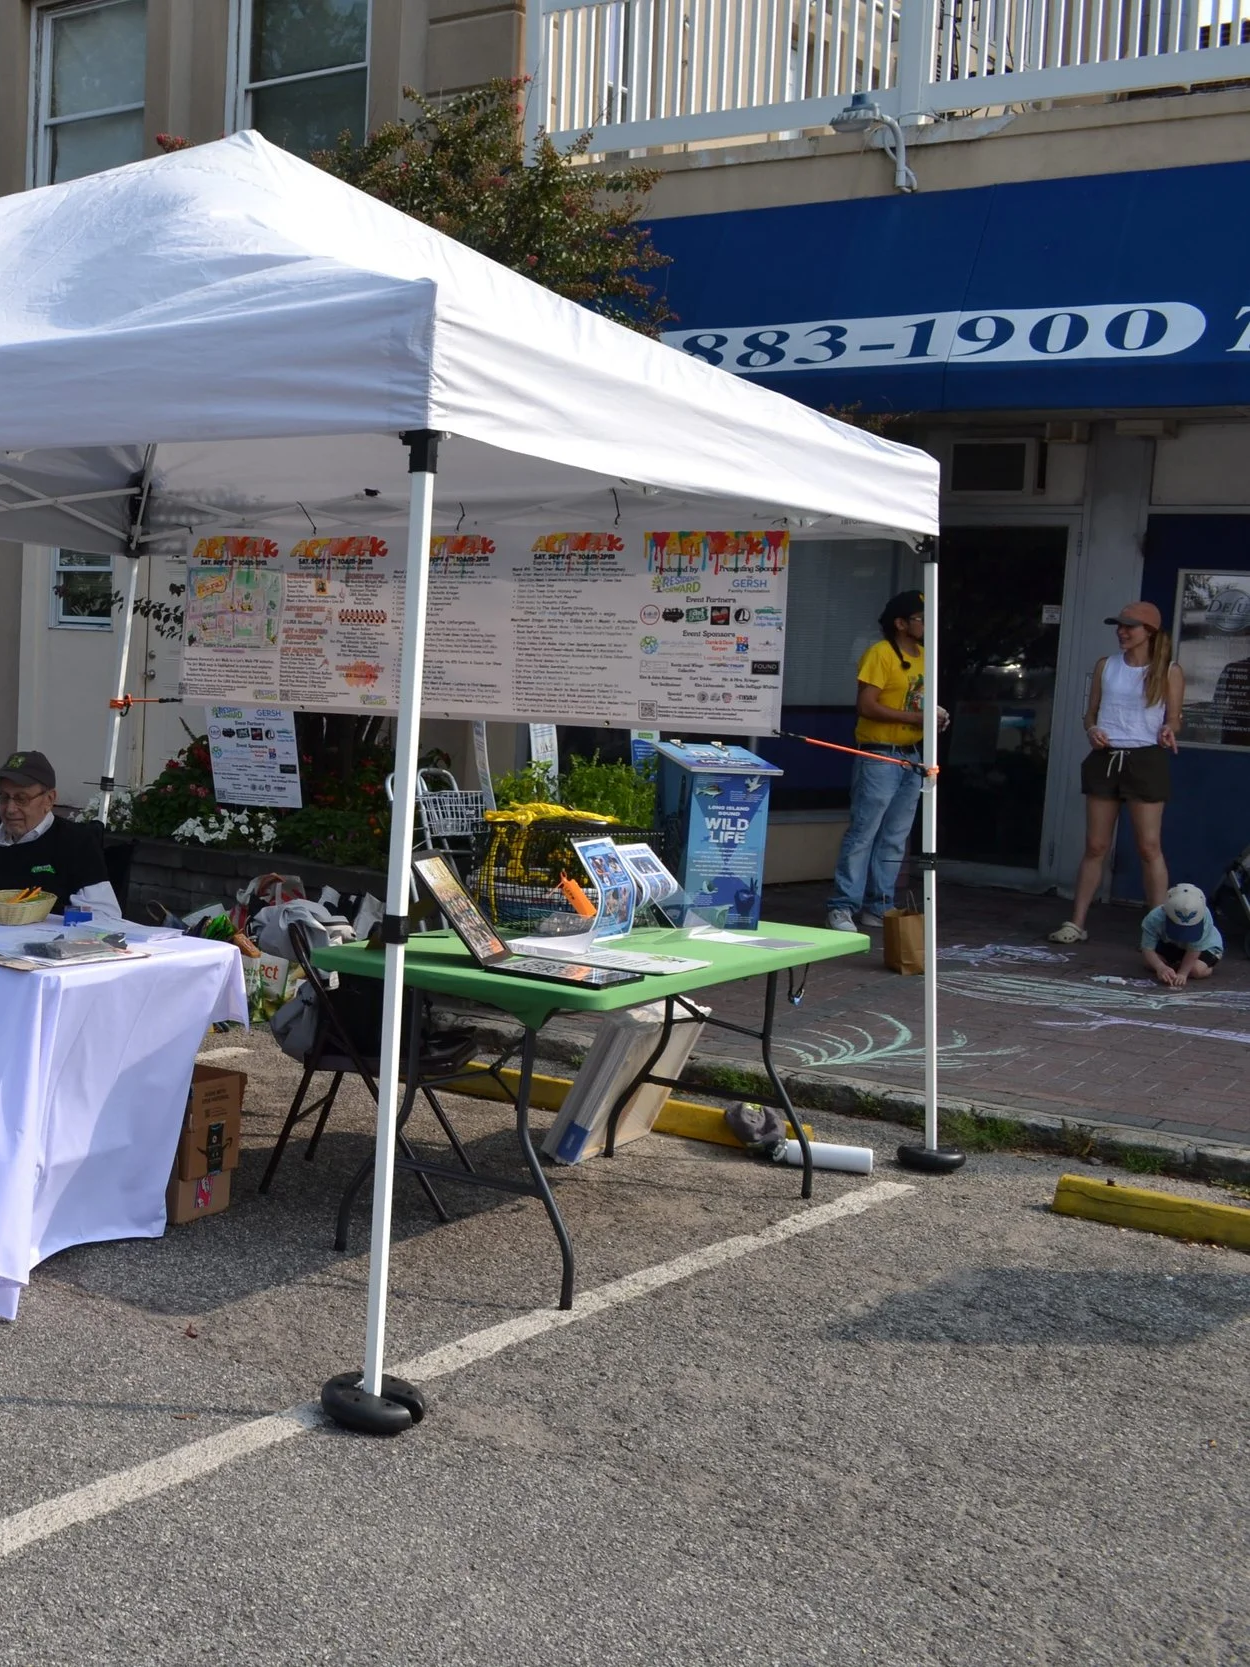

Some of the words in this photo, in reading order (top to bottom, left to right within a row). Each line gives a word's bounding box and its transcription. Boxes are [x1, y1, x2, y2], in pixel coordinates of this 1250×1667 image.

[719, 565, 754, 573] Presenting
[755, 565, 784, 573] Sponsor
[732, 579, 767, 588] GERSH
[703, 630, 735, 638] Sponsors
[705, 817, 749, 831] WILD
[709, 831, 745, 844] LIFE
